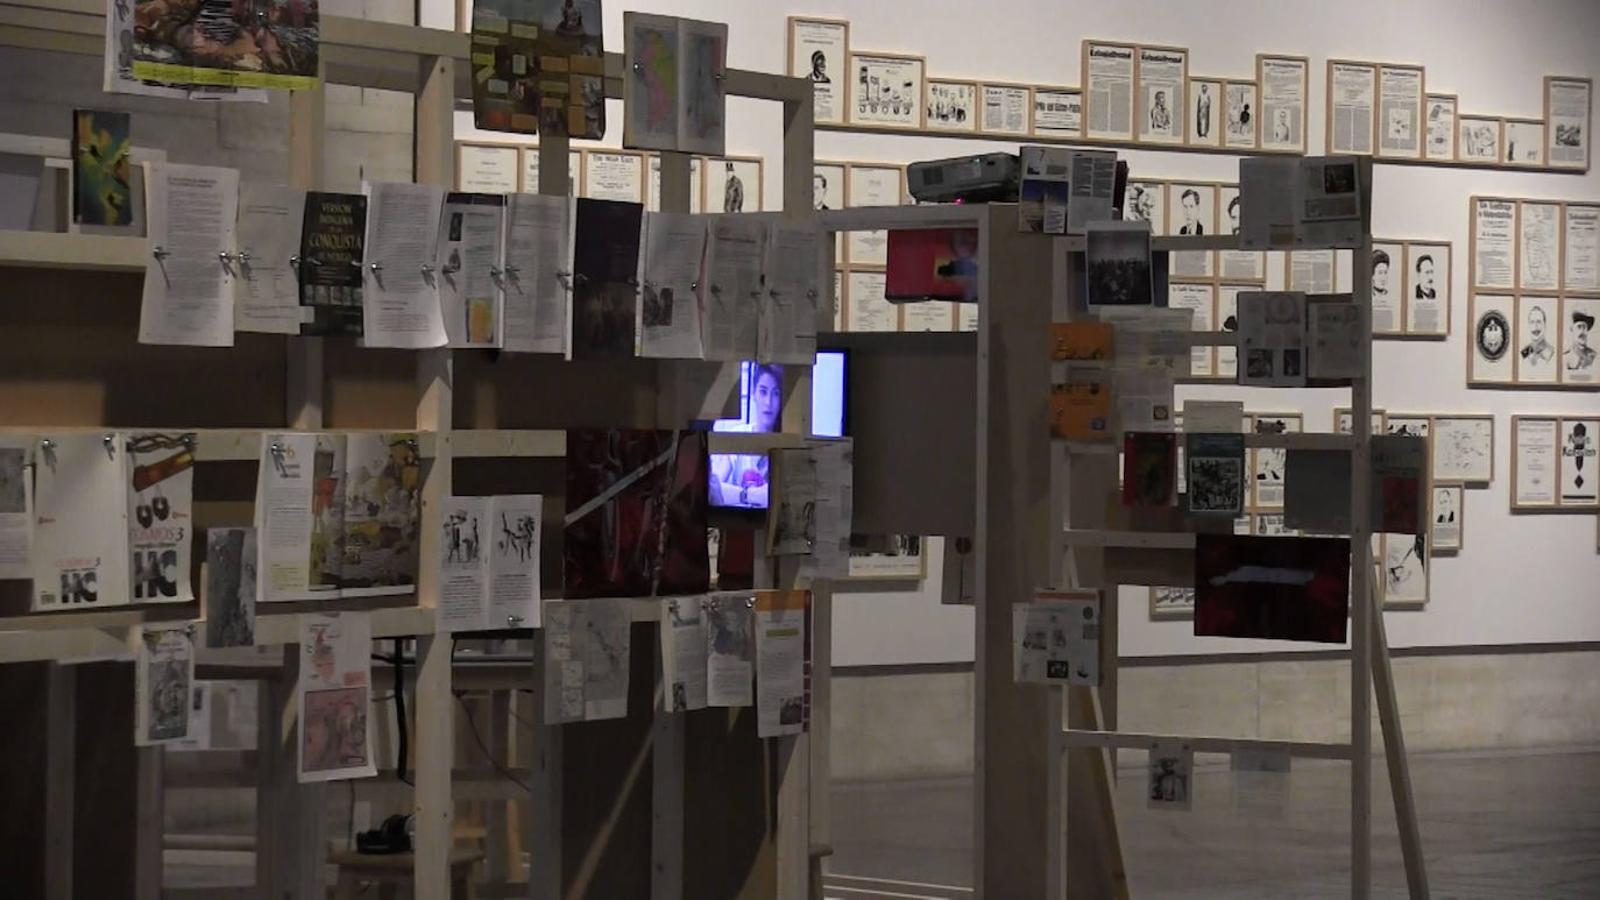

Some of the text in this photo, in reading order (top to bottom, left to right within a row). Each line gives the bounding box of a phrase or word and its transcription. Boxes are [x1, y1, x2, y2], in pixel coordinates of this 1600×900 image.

[175, 527, 185, 542] 3
[61, 572, 98, 604] HC
[134, 550, 177, 599] HC
